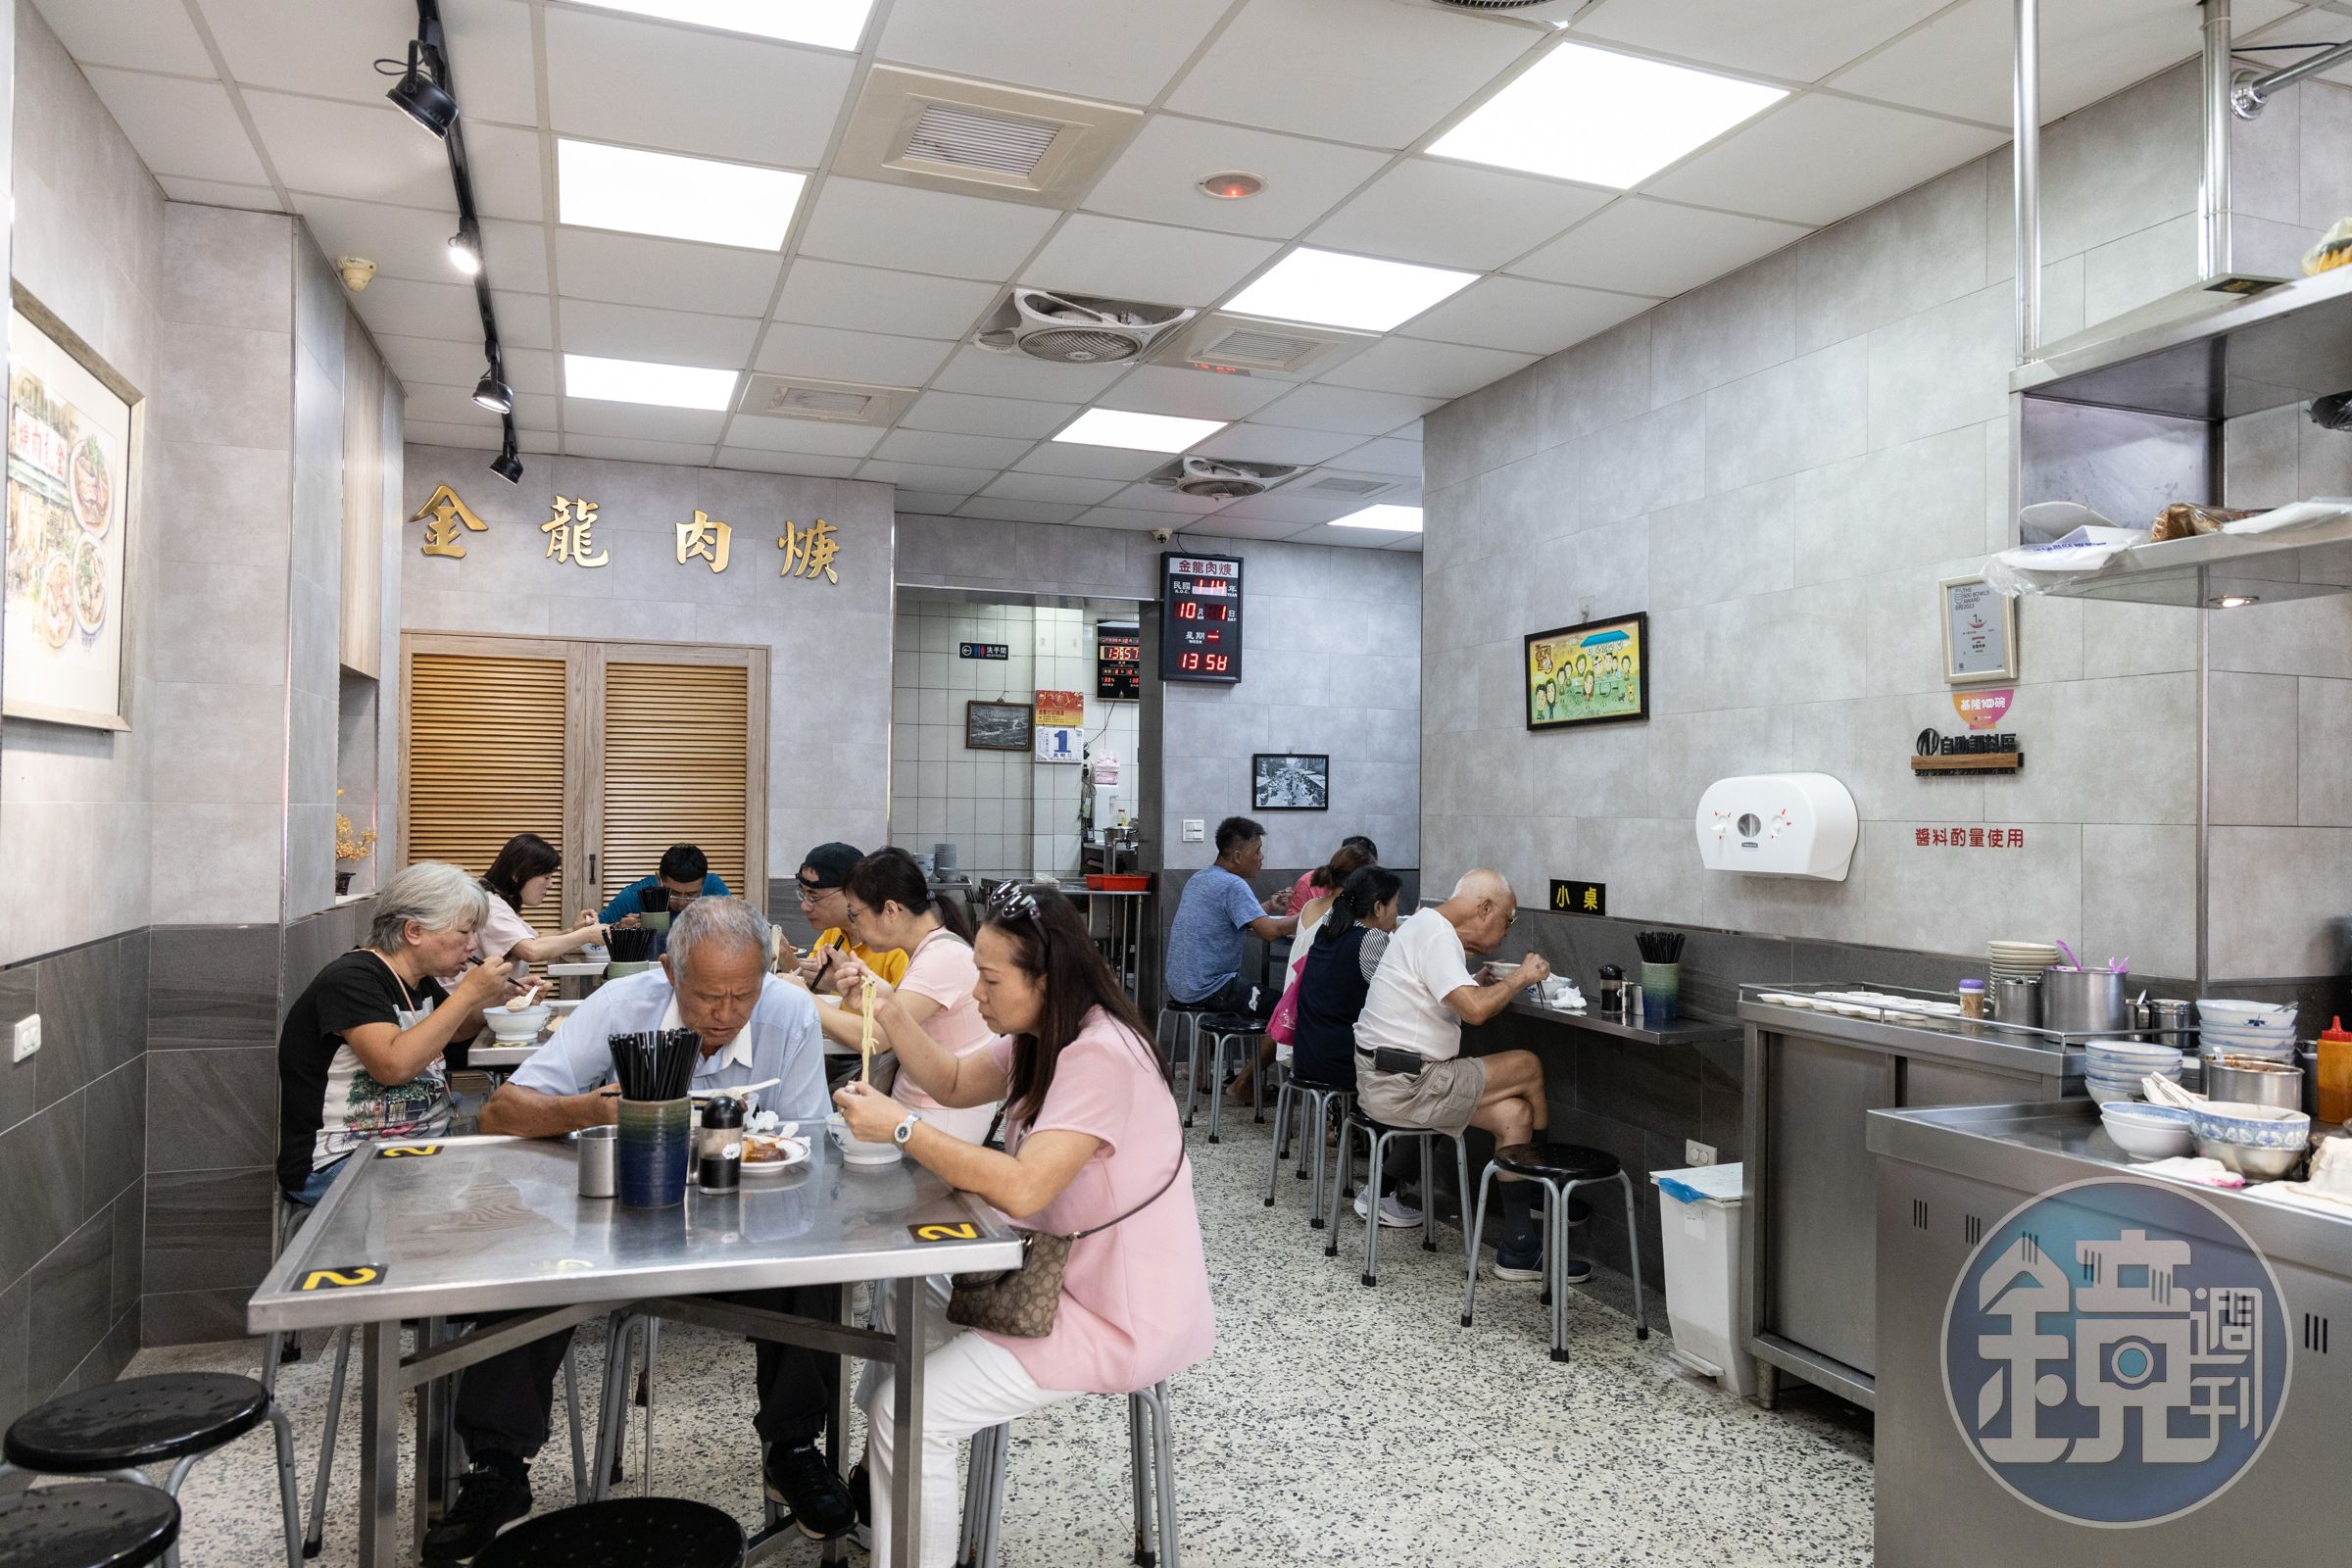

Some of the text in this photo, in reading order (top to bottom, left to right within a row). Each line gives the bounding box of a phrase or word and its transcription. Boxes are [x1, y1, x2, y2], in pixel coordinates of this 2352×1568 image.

[408, 483, 840, 585] 金龍肉焿
[1178, 560, 1231, 576] 金龍肉焿
[1174, 581, 1190, 590] 民國
[1180, 603, 1196, 618] 10
[1186, 631, 1205, 640] 星期
[1054, 730, 1071, 753] 1
[1915, 828, 2024, 848] 醬料酌量使用
[1556, 884, 1597, 910] 小桌
[917, 1223, 978, 1241] 2
[302, 1267, 377, 1291] 2
